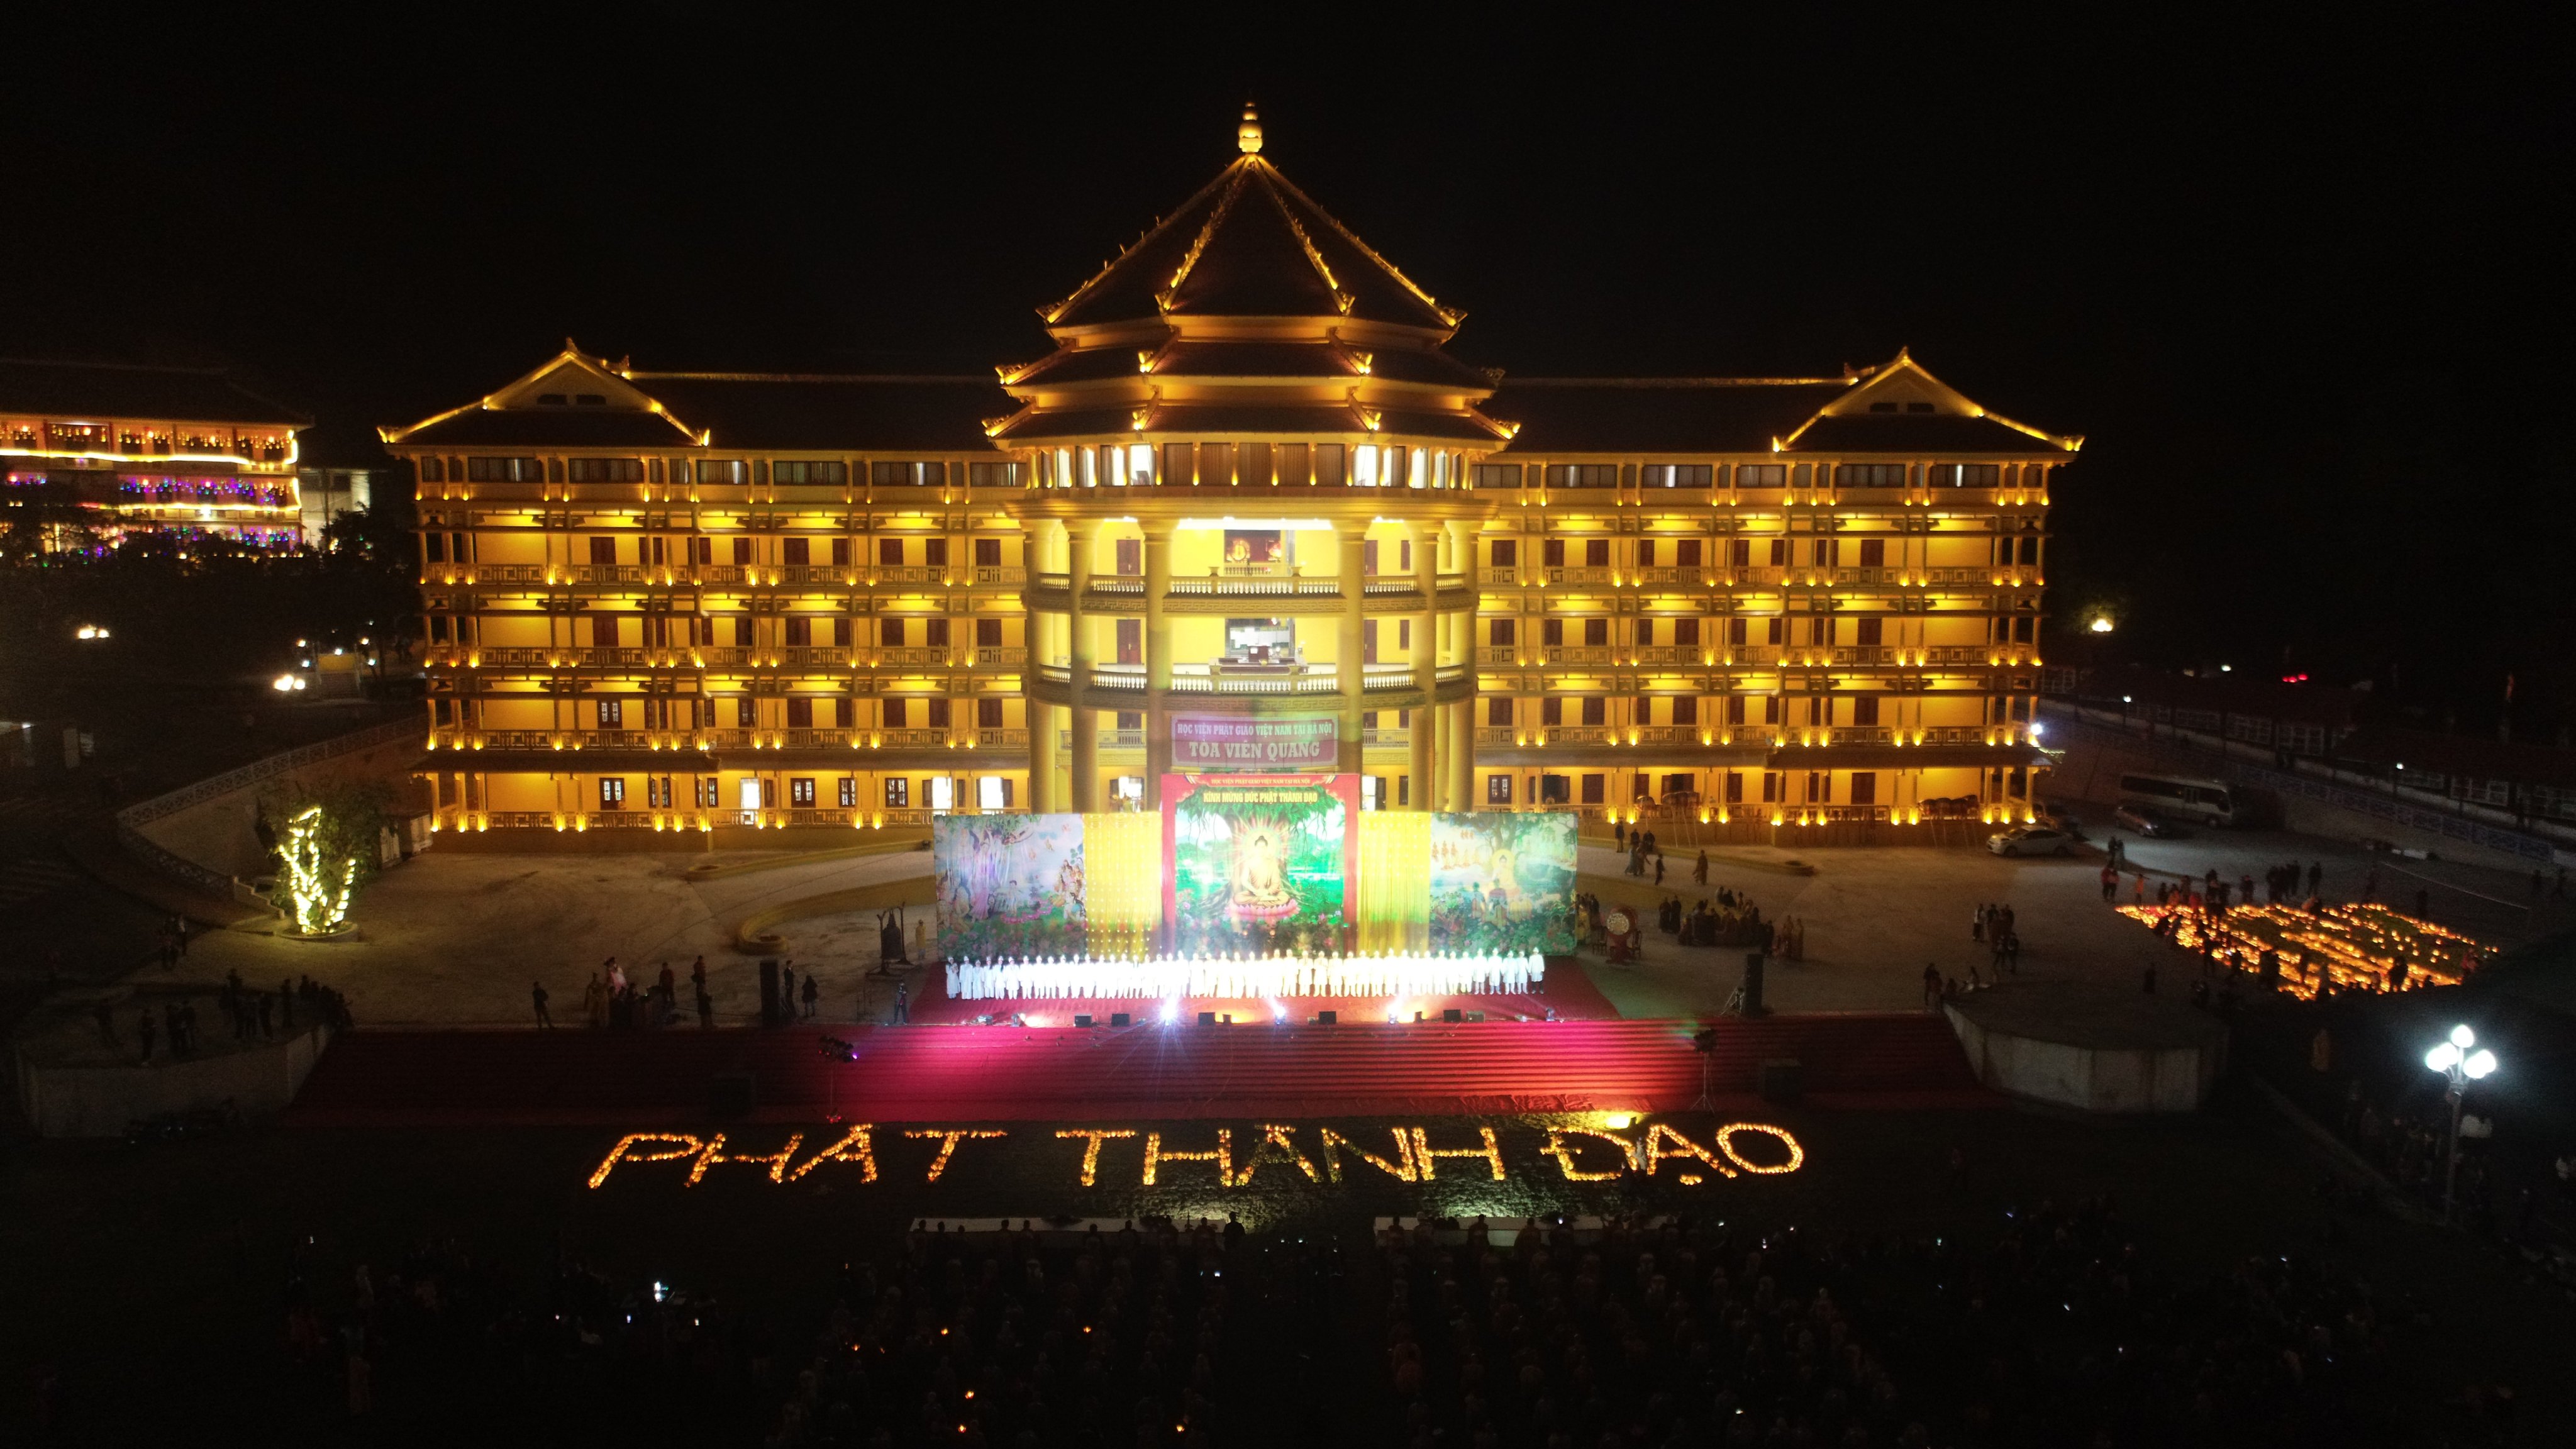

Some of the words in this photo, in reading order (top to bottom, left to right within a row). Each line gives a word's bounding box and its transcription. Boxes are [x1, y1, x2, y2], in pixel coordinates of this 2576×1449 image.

[1177, 724, 1193, 736] HỌC
[1194, 723, 1212, 737] VIỆN
[1213, 723, 1234, 738] PHẬT
[1235, 724, 1254, 736] GIÁO
[1255, 723, 1273, 738] VIỆT
[1274, 724, 1292, 735] NAM
[1293, 724, 1306, 737] TẠI
[1307, 723, 1318, 735] HÀ
[1318, 721, 1332, 736] NỘI
[1189, 739, 1221, 758] TÒA
[1224, 740, 1262, 758] VIÊN
[1267, 741, 1320, 762] QUANG
[1203, 791, 1221, 802] KÍNH
[1222, 791, 1243, 802] MỪNG
[1245, 791, 1258, 802] ĐỨC
[1259, 791, 1277, 804] PHẬT
[1279, 791, 1302, 802] THÀNH
[1304, 792, 1318, 804] ĐẠO
[1540, 1122, 1805, 1185] ĐẠO
